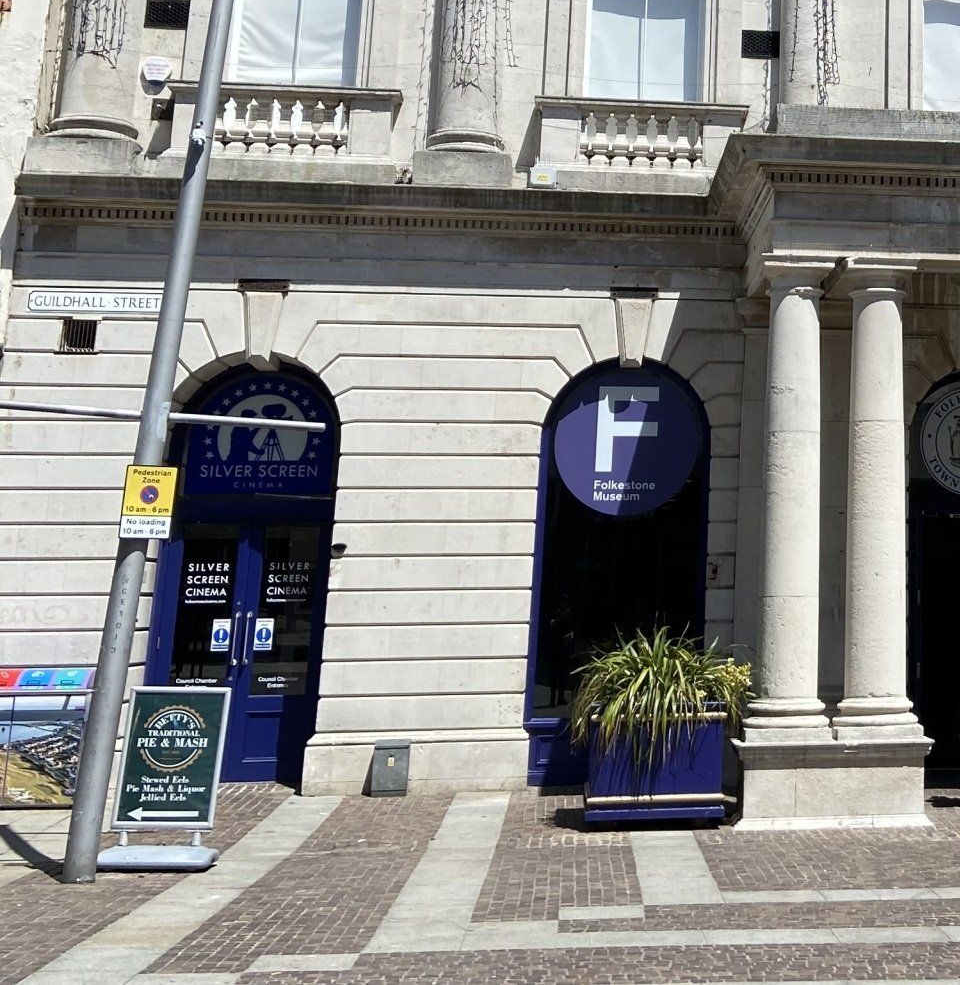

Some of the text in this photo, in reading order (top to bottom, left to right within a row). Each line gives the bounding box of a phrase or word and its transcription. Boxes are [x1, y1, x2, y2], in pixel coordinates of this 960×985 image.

[34, 296, 161, 309] GUILDHALL STREET
[595, 387, 660, 472] F
[200, 465, 318, 477] SILVER SCREEN
[929, 456, 959, 488] TOWN
[233, 481, 284, 489] CINEMA
[594, 480, 656, 490] Folkestone
[593, 492, 640, 501] Museum
[188, 563, 230, 572] SILVER
[269, 562, 310, 571] SILVER
[187, 575, 229, 584] SCREEN
[268, 574, 309, 583] SCREEN
[185, 588, 227, 596] CINEMA
[266, 586, 308, 595] CINEMA
[137, 738, 208, 747] PIE & MASH
[141, 775, 169, 783] Stewed
[126, 784, 140, 792] Pie
[178, 785, 206, 794] Liquor
[139, 793, 166, 802] Jellied
